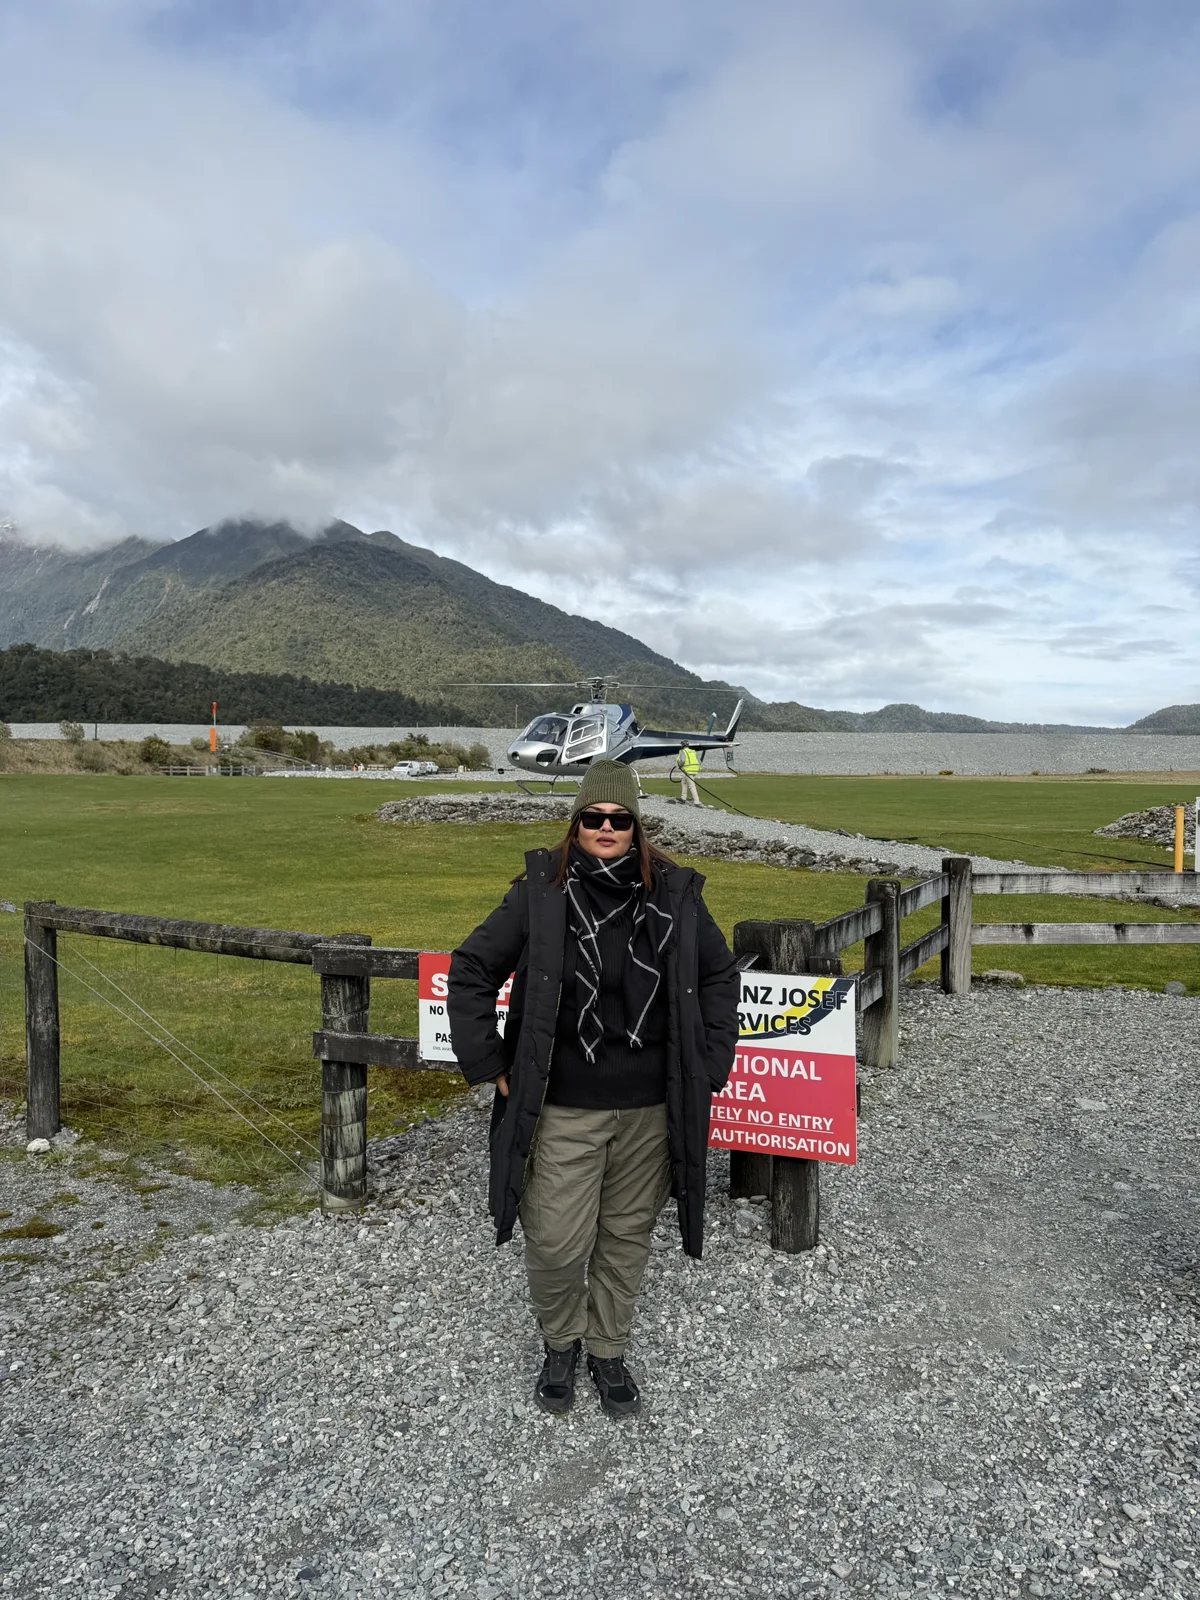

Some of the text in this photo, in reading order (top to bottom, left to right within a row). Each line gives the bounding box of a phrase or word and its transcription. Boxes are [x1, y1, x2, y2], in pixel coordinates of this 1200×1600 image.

[739, 985, 848, 1011] NZ JOSEF
[429, 1005, 444, 1016] NO
[711, 1080, 767, 1103] REA
[747, 1109, 773, 1125] NO
[778, 1114, 834, 1131] ENTRY
[711, 1128, 850, 1157] AUTHORISATION
